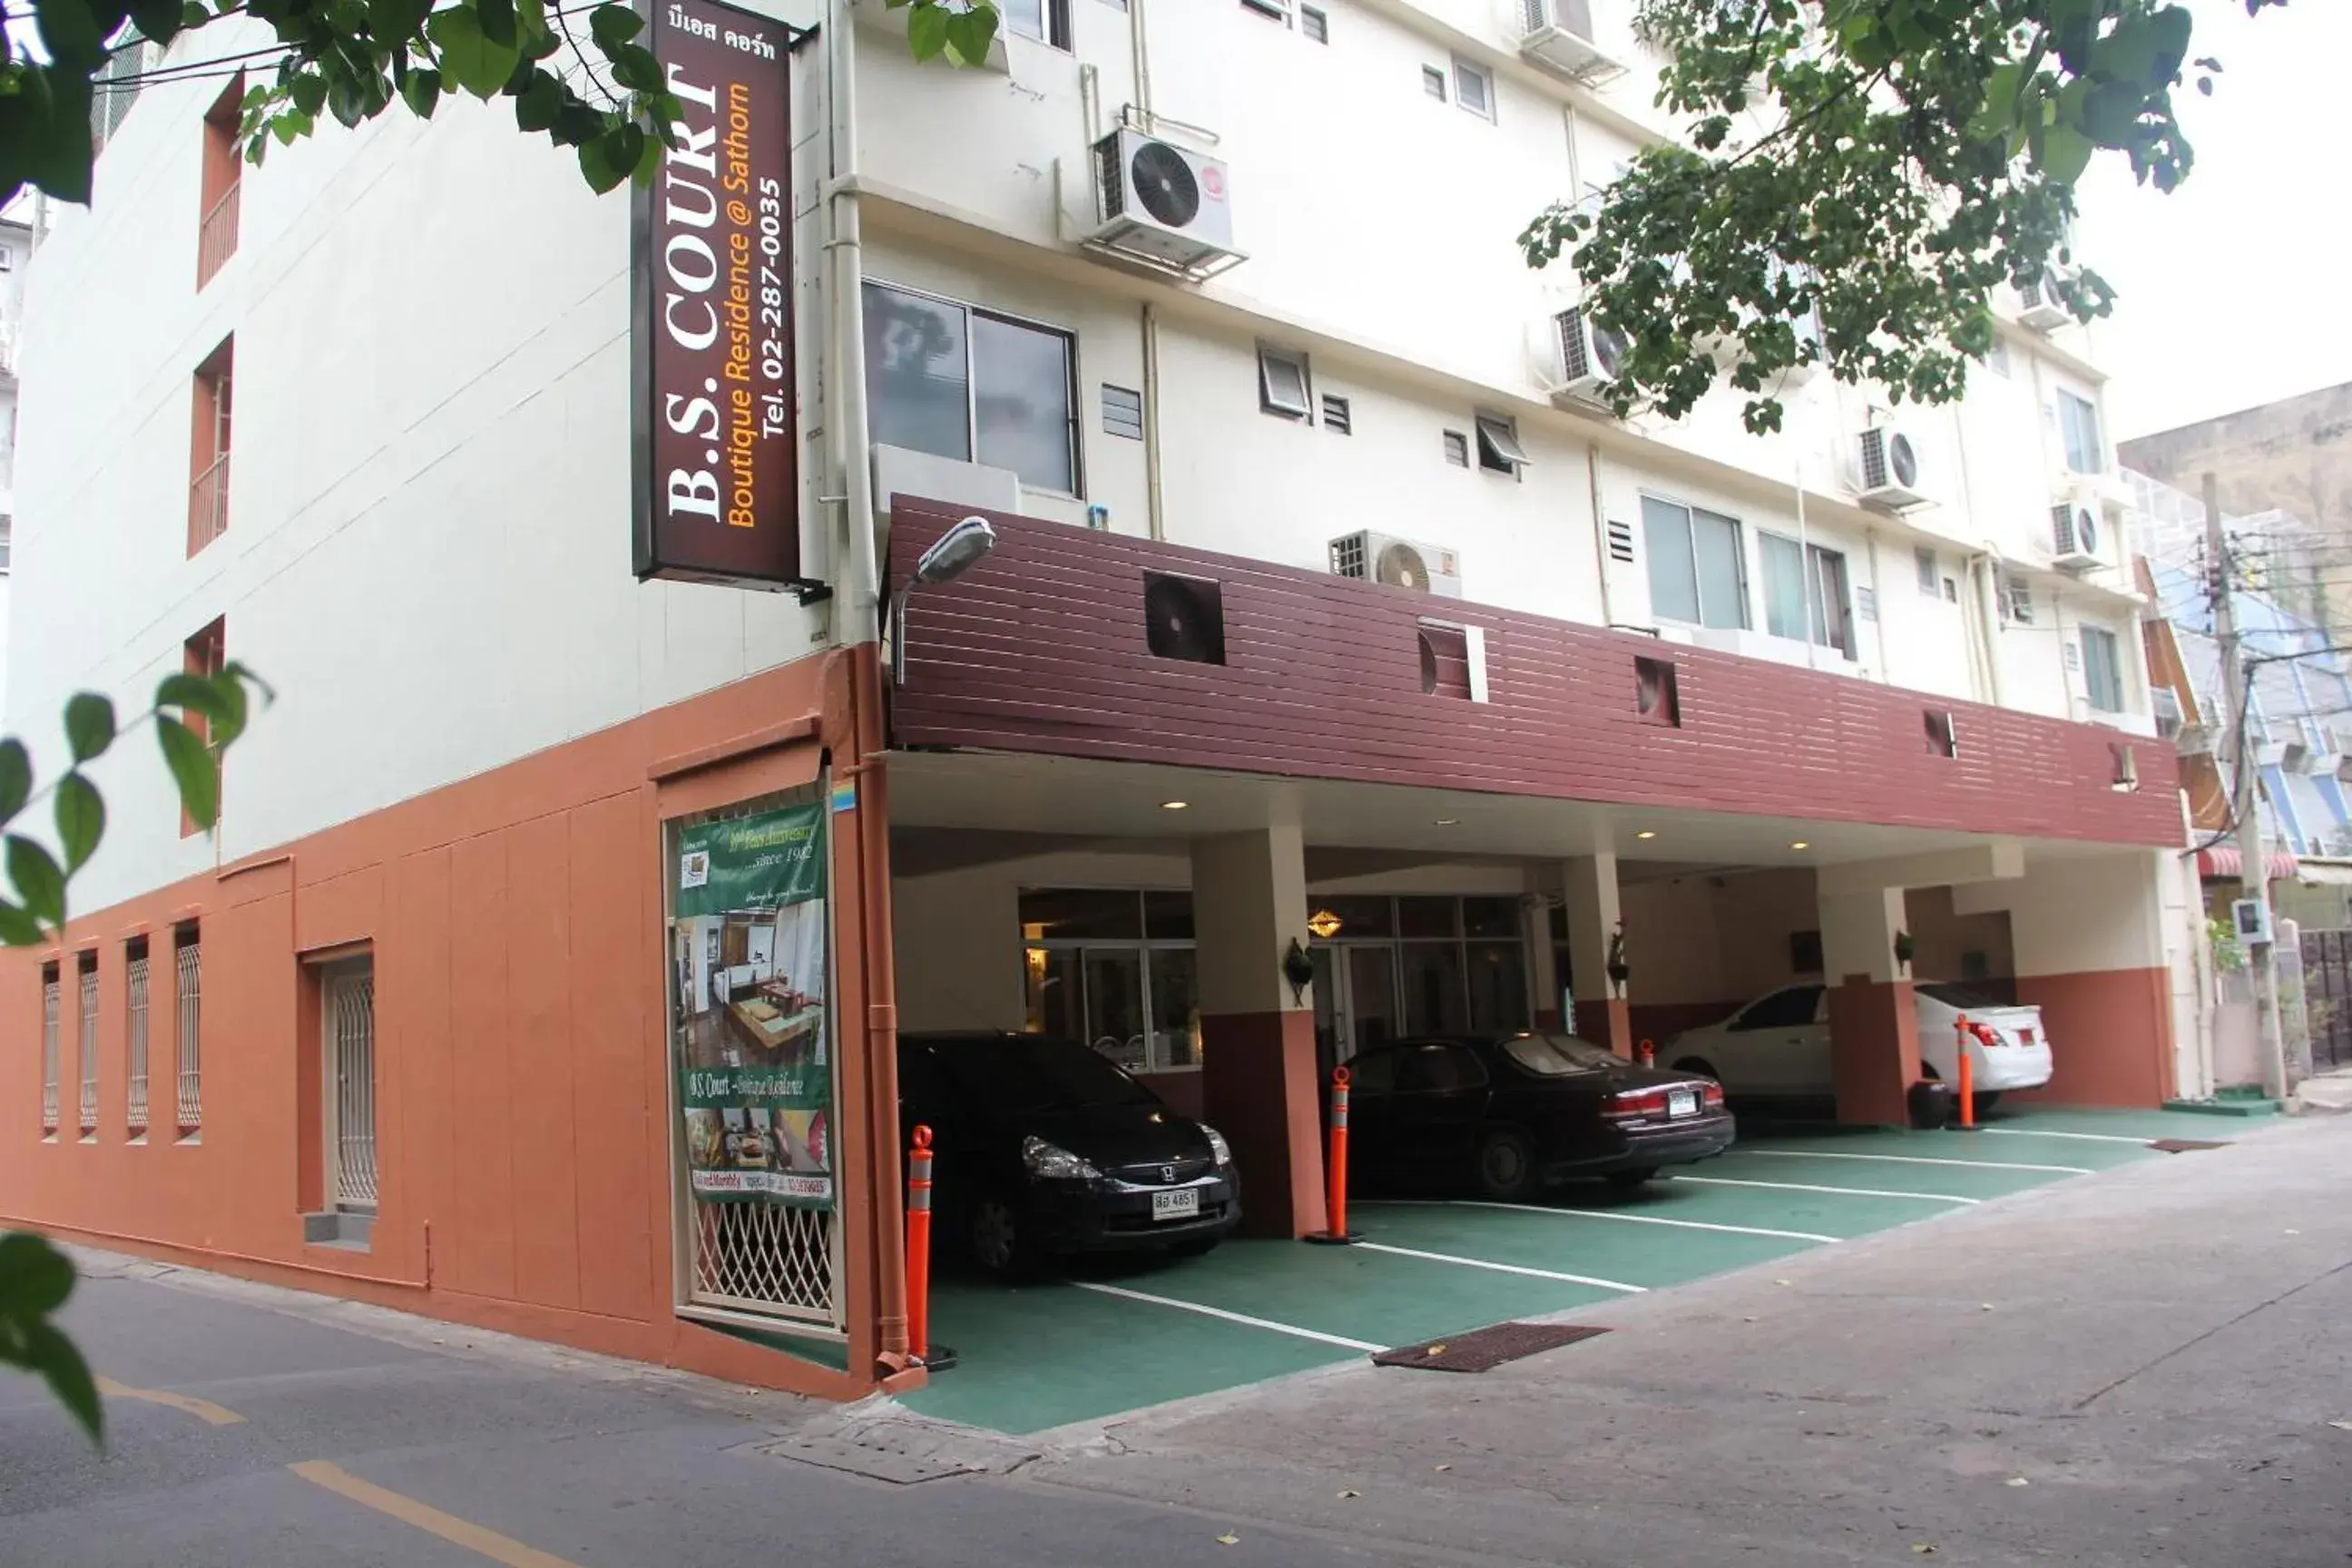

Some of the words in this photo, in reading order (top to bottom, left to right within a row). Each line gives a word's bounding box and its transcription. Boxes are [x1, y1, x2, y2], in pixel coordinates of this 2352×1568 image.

[665, 62, 718, 350] COURT
[723, 83, 750, 194] Sathorn
[723, 232, 751, 381] Residence
[760, 177, 783, 379] 02-287-0035
[666, 377, 720, 524] B.S.
[728, 389, 759, 528] Boutique
[761, 388, 784, 439] Tel.
